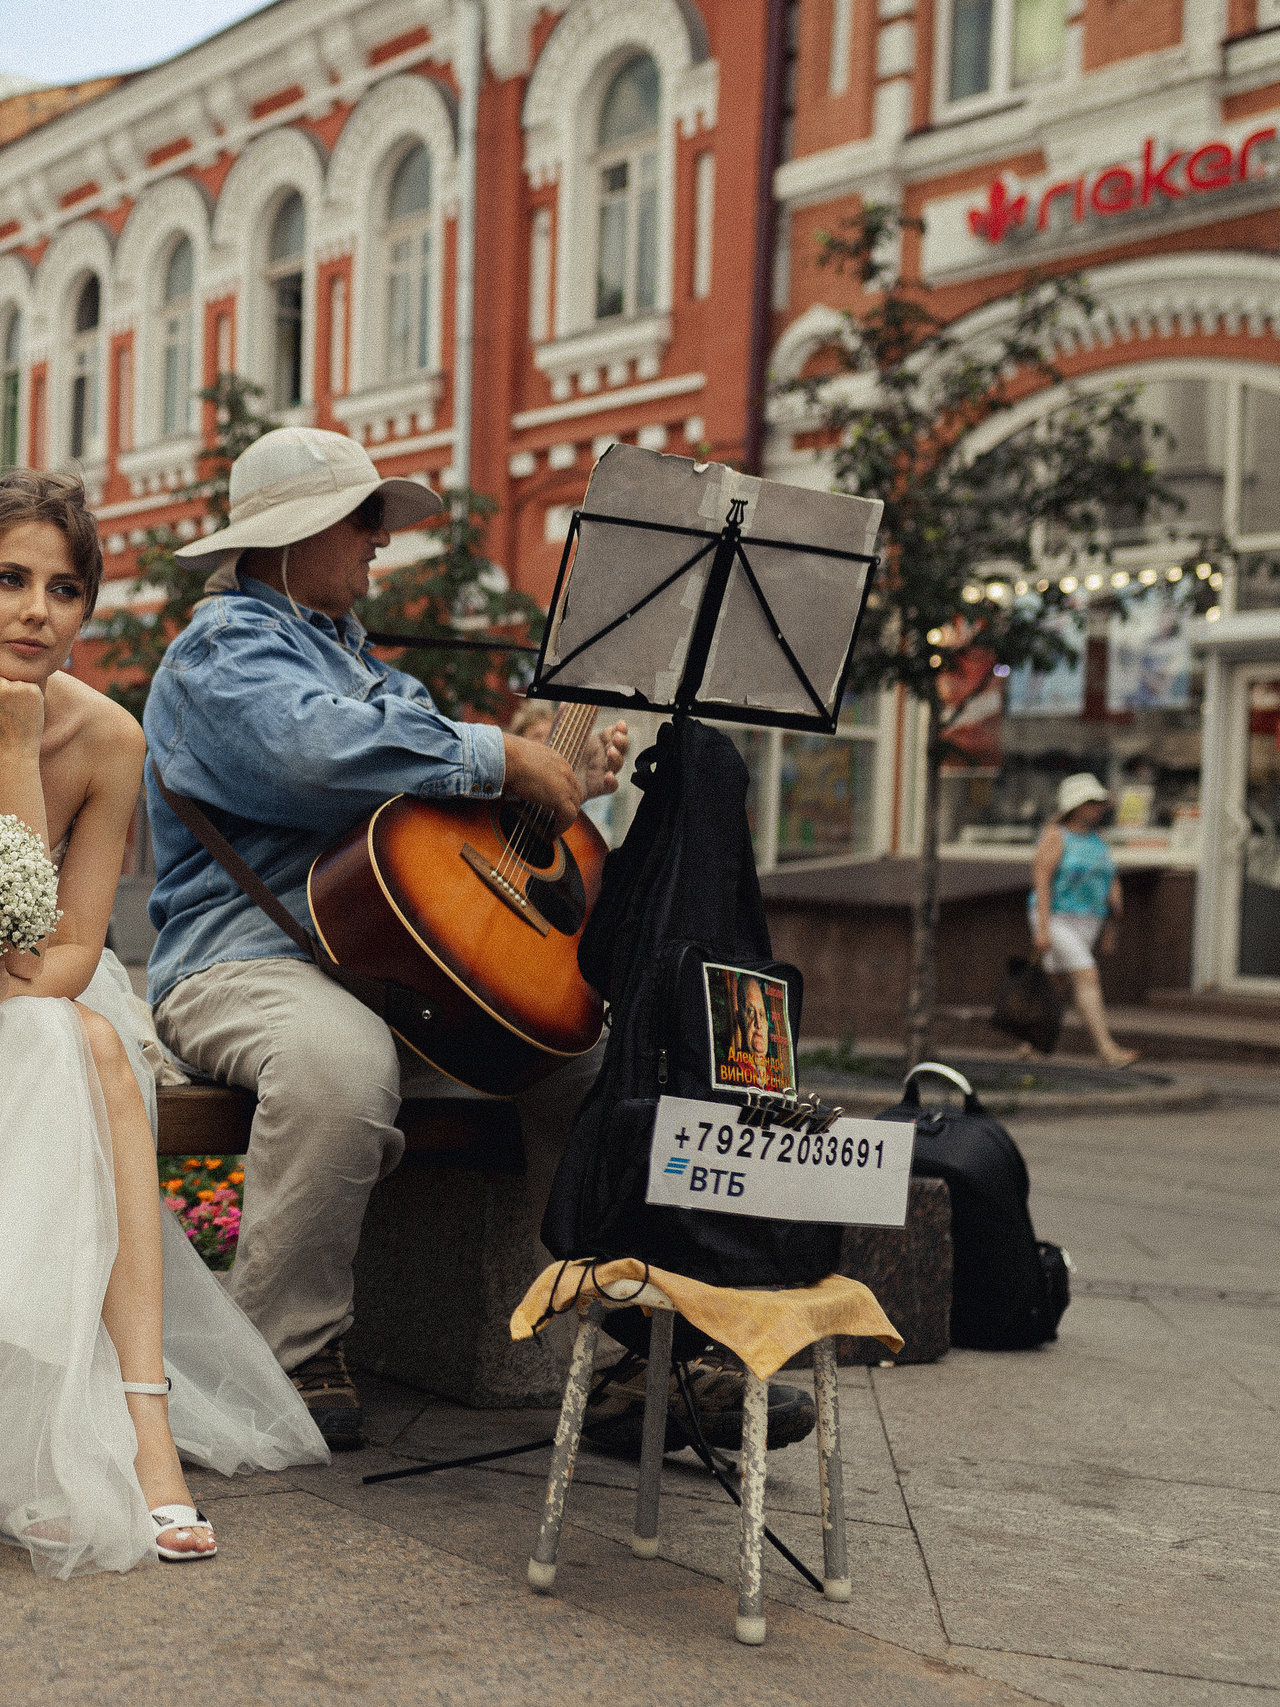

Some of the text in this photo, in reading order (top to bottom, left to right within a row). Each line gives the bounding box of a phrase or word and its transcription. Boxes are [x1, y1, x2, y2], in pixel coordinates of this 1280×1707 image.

[1034, 126, 1277, 234] rieker
[674, 1121, 884, 1169] +79272033691
[689, 1165, 747, 1197] ВТБ
